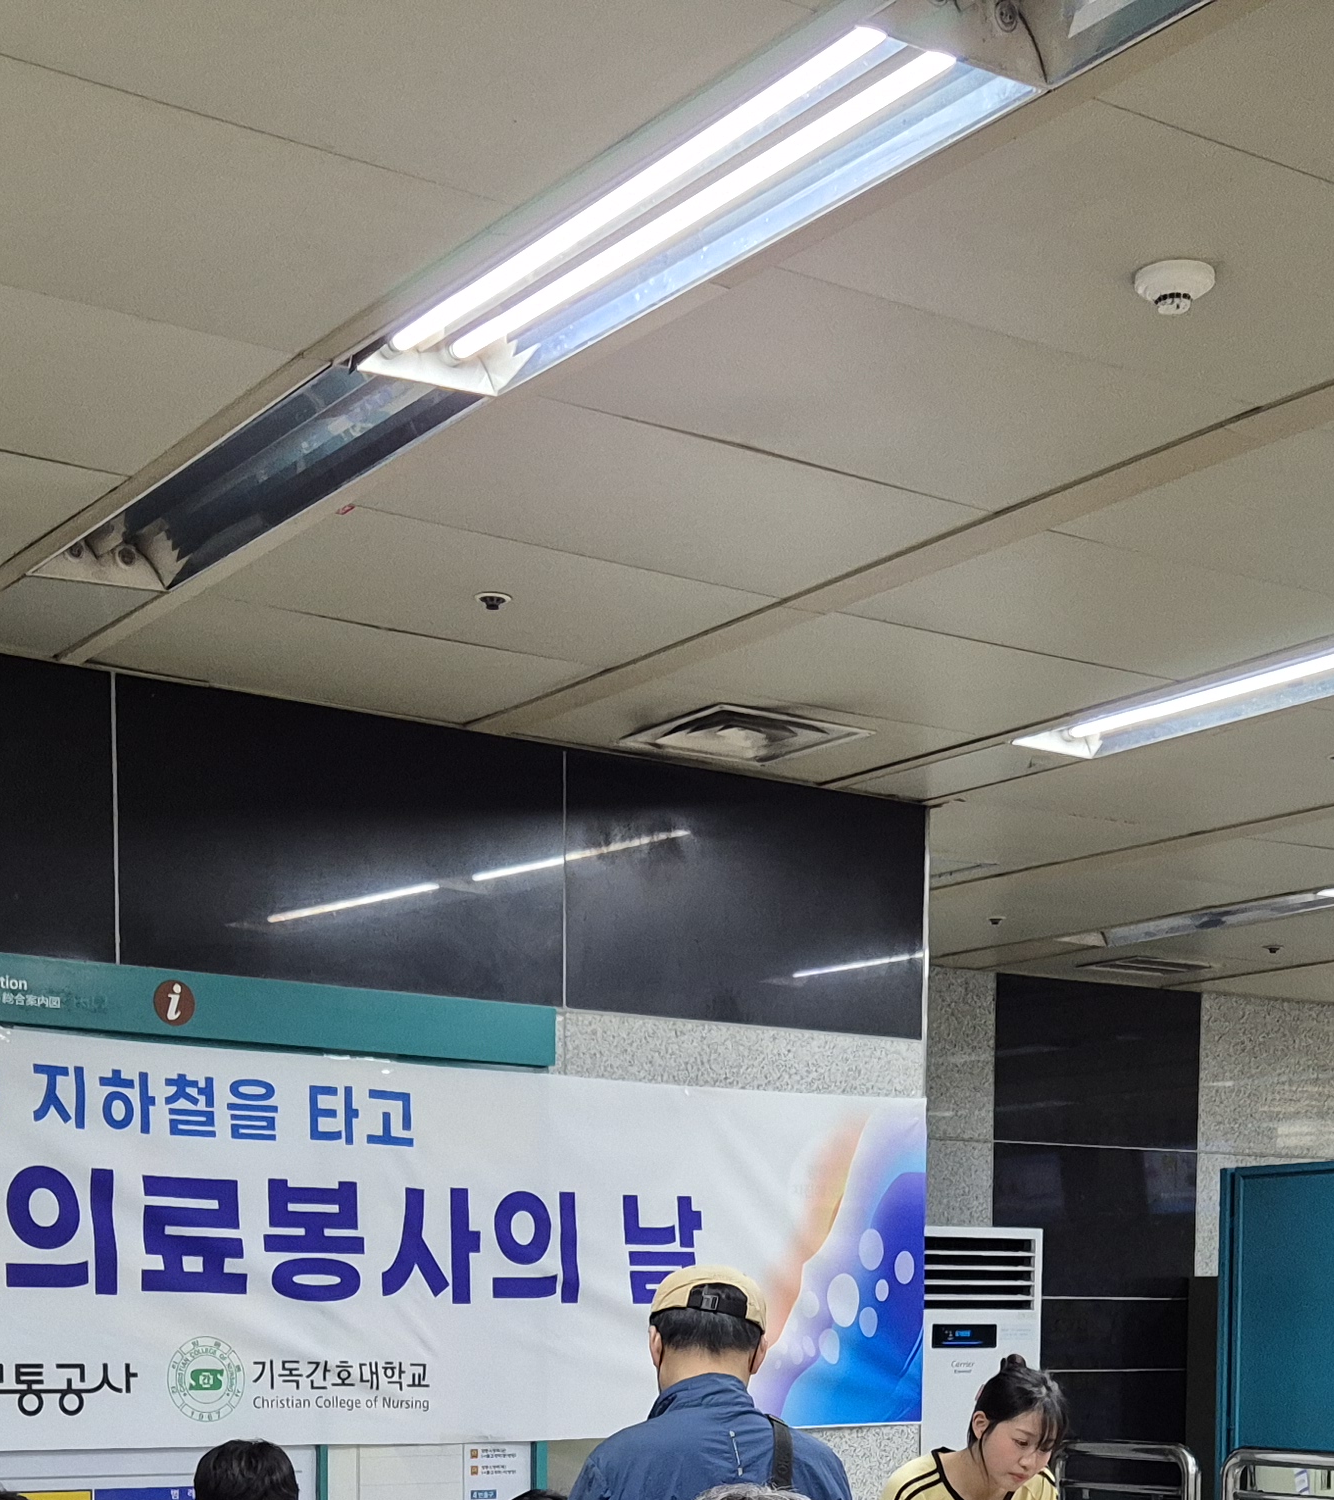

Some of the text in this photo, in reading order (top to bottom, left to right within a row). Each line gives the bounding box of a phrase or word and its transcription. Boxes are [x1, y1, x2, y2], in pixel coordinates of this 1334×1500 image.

[32, 1063, 279, 1142] 지하철을
[309, 1085, 415, 1148] 타고
[5, 1164, 580, 1304] 의료봉사의
[623, 1194, 703, 1304] 날
[252, 1359, 430, 1391] 기독간호대학교
[253, 1396, 430, 1411] Christian College of Nursing
